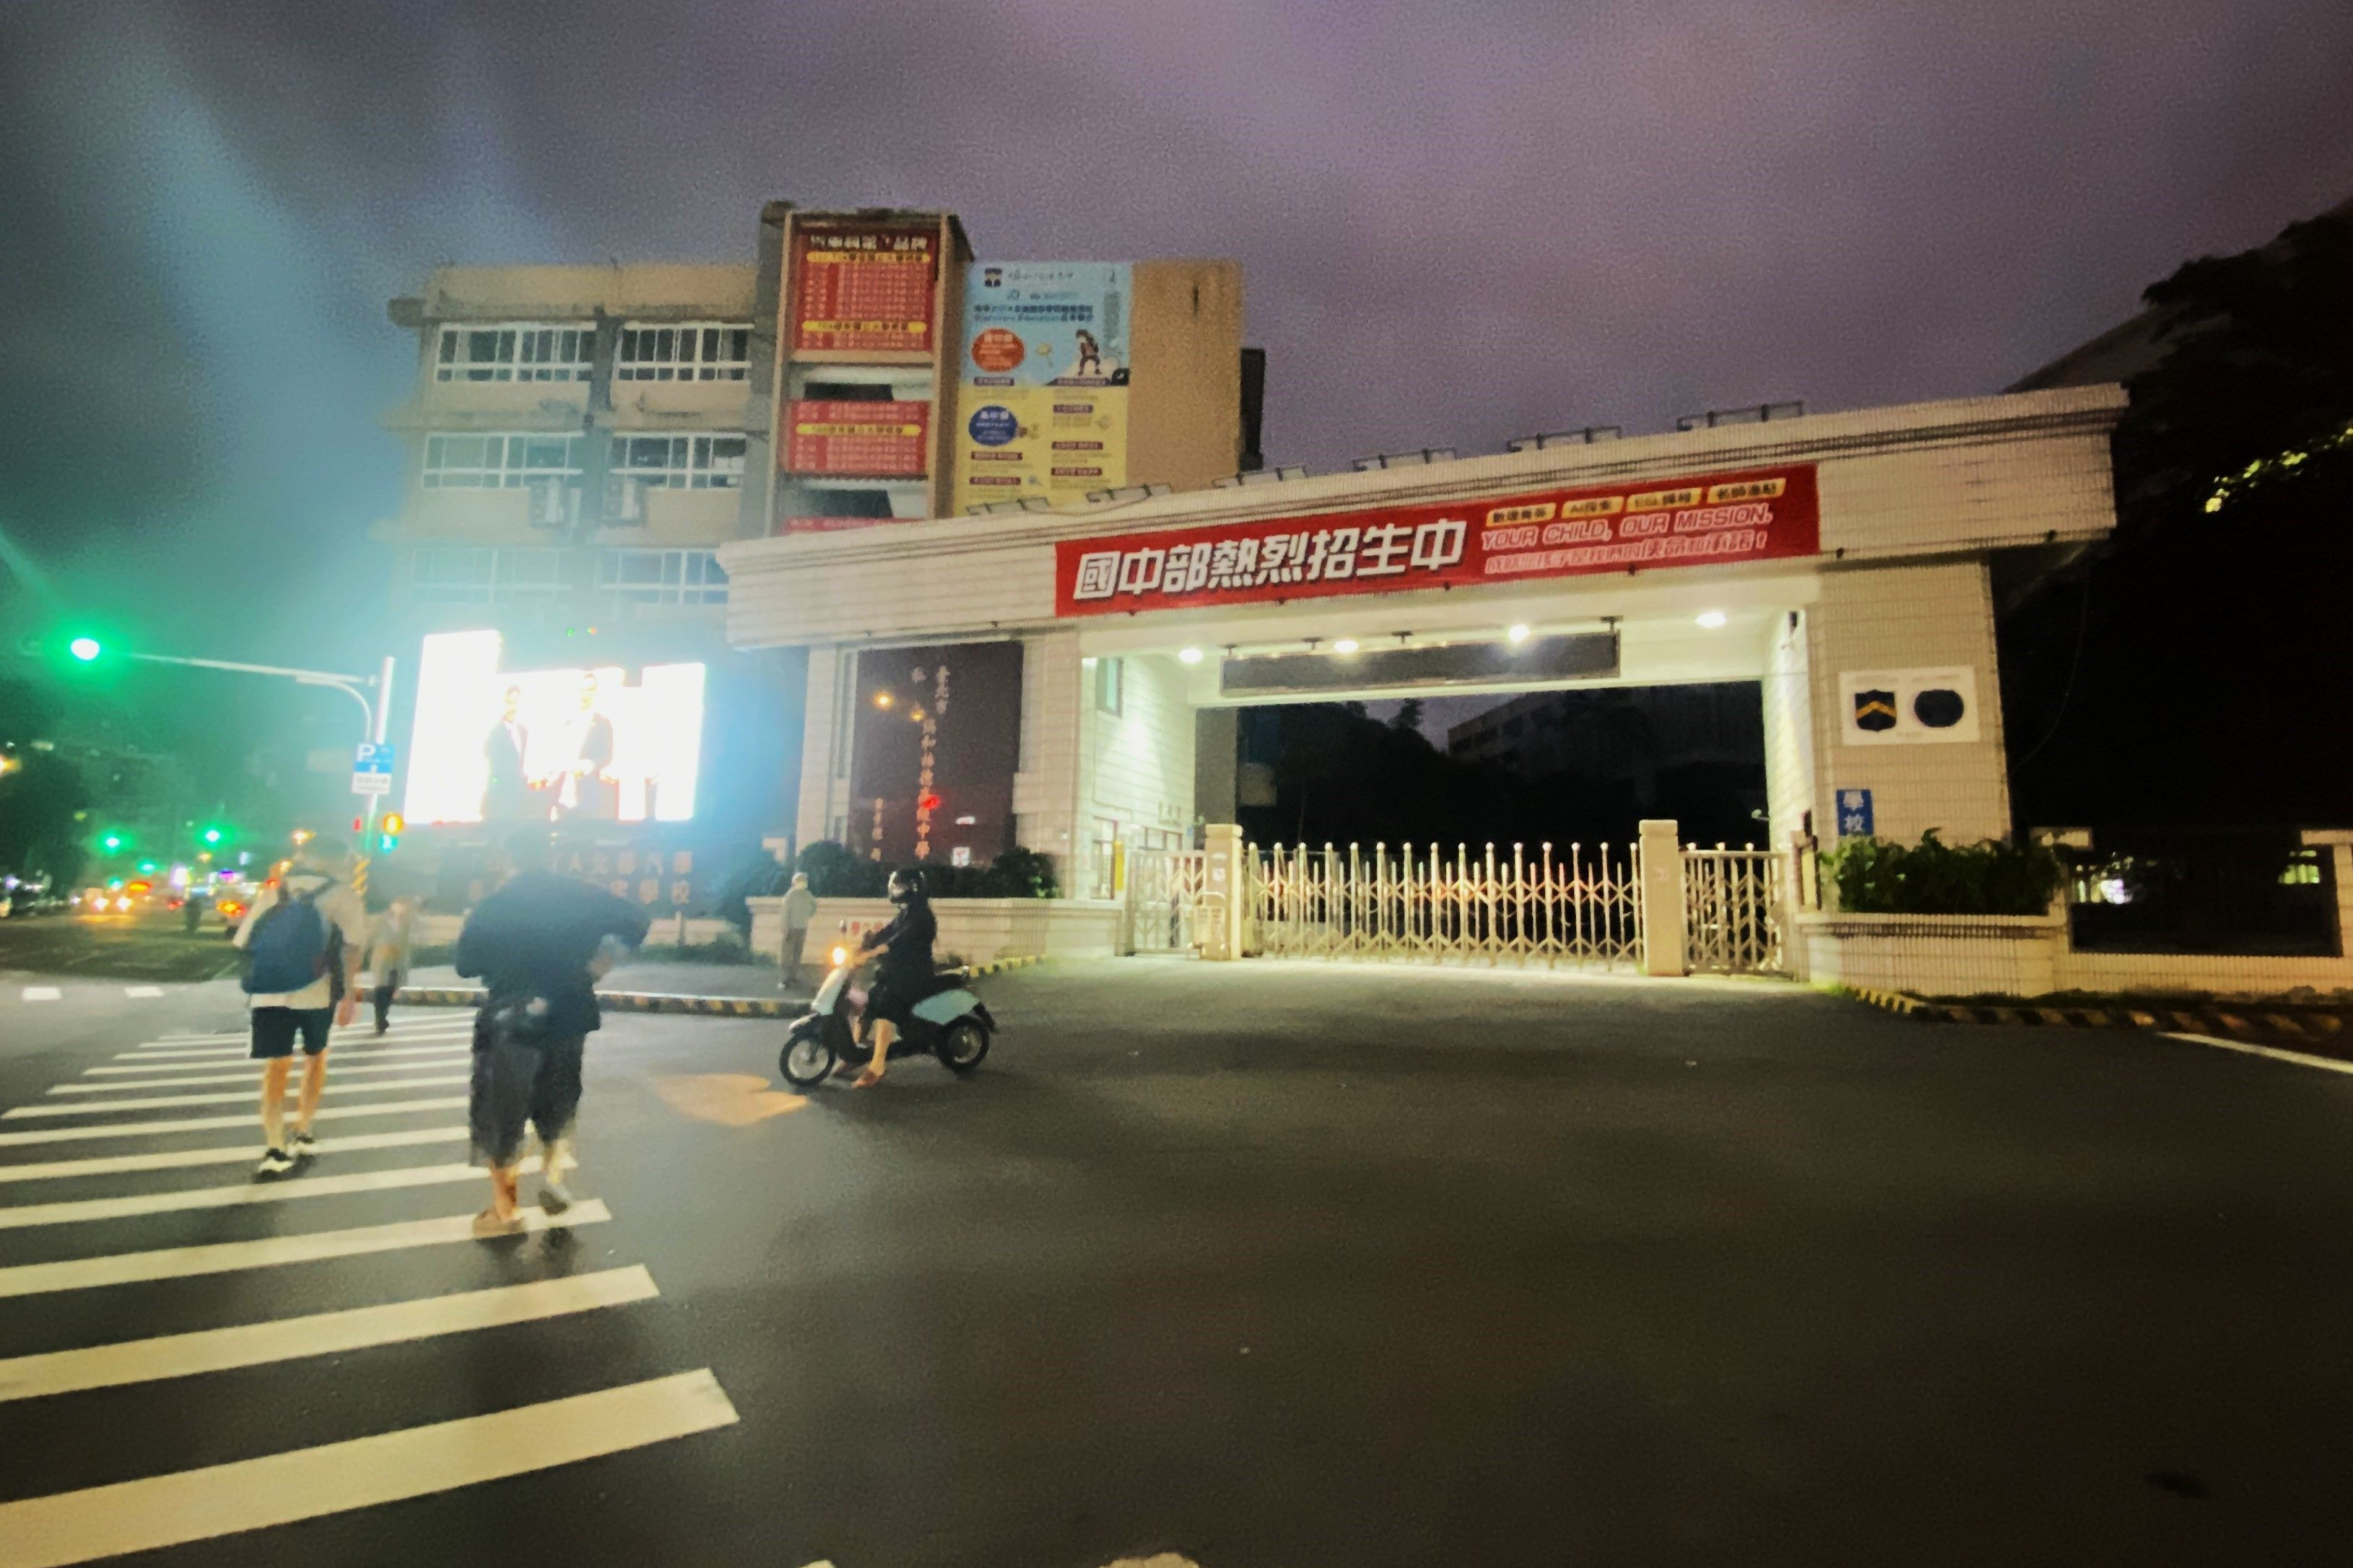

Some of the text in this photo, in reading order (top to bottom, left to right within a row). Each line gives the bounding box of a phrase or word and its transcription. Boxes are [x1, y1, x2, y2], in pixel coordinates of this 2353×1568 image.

[1073, 518, 1467, 600] 國中部熱烈招生中
[1482, 526, 1539, 551] YOUR
[1542, 518, 1613, 545] CHILD,
[1619, 513, 1670, 537] OUR
